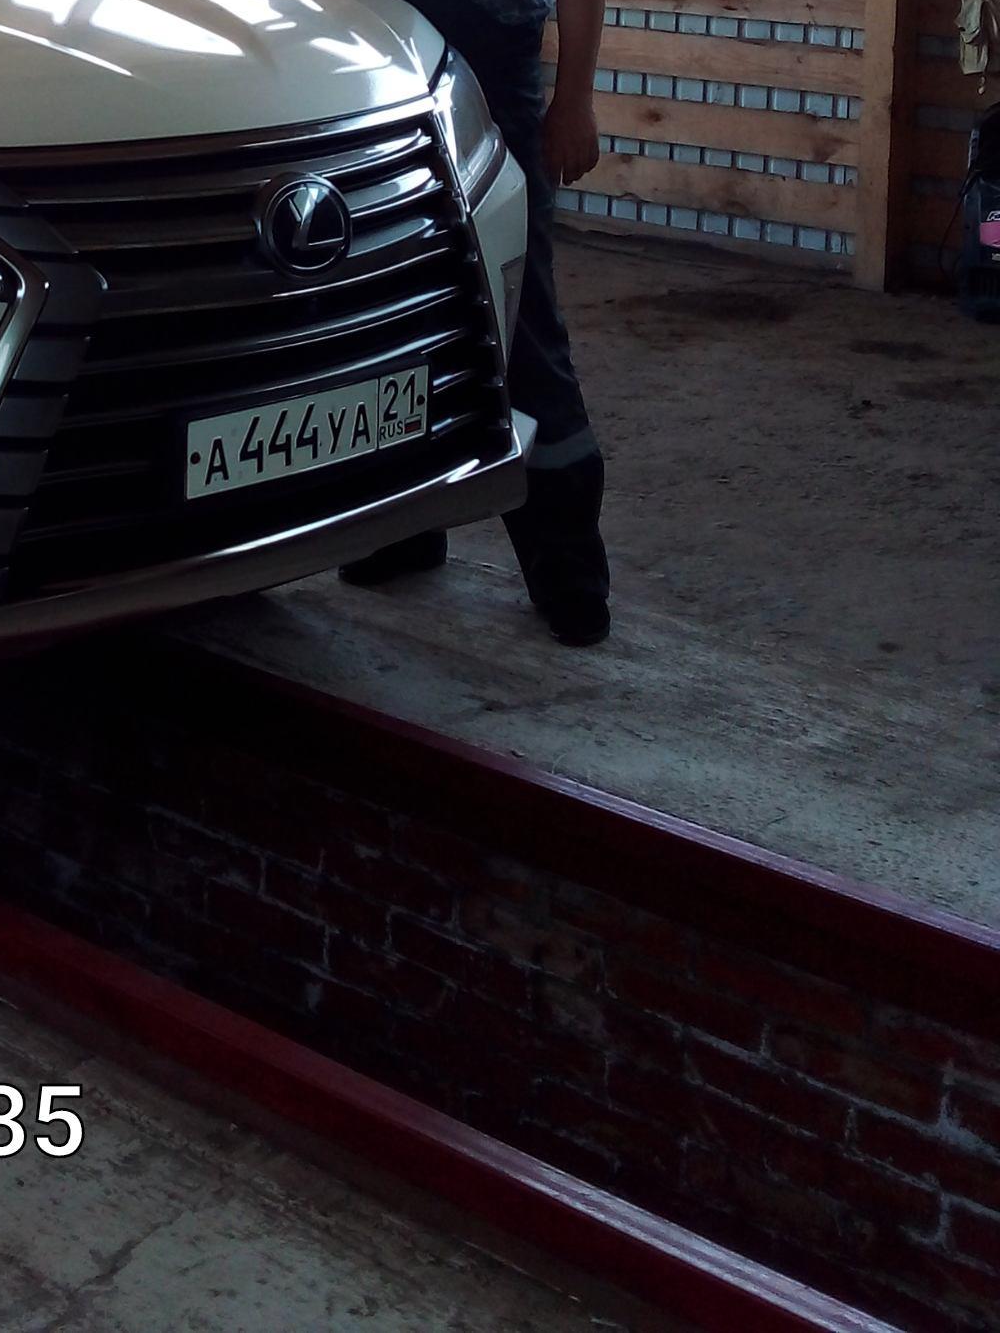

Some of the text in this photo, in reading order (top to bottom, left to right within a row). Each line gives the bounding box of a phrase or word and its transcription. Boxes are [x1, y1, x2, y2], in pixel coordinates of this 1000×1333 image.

[205, 372, 416, 485] А444УА 21
[379, 422, 404, 442] RUS
